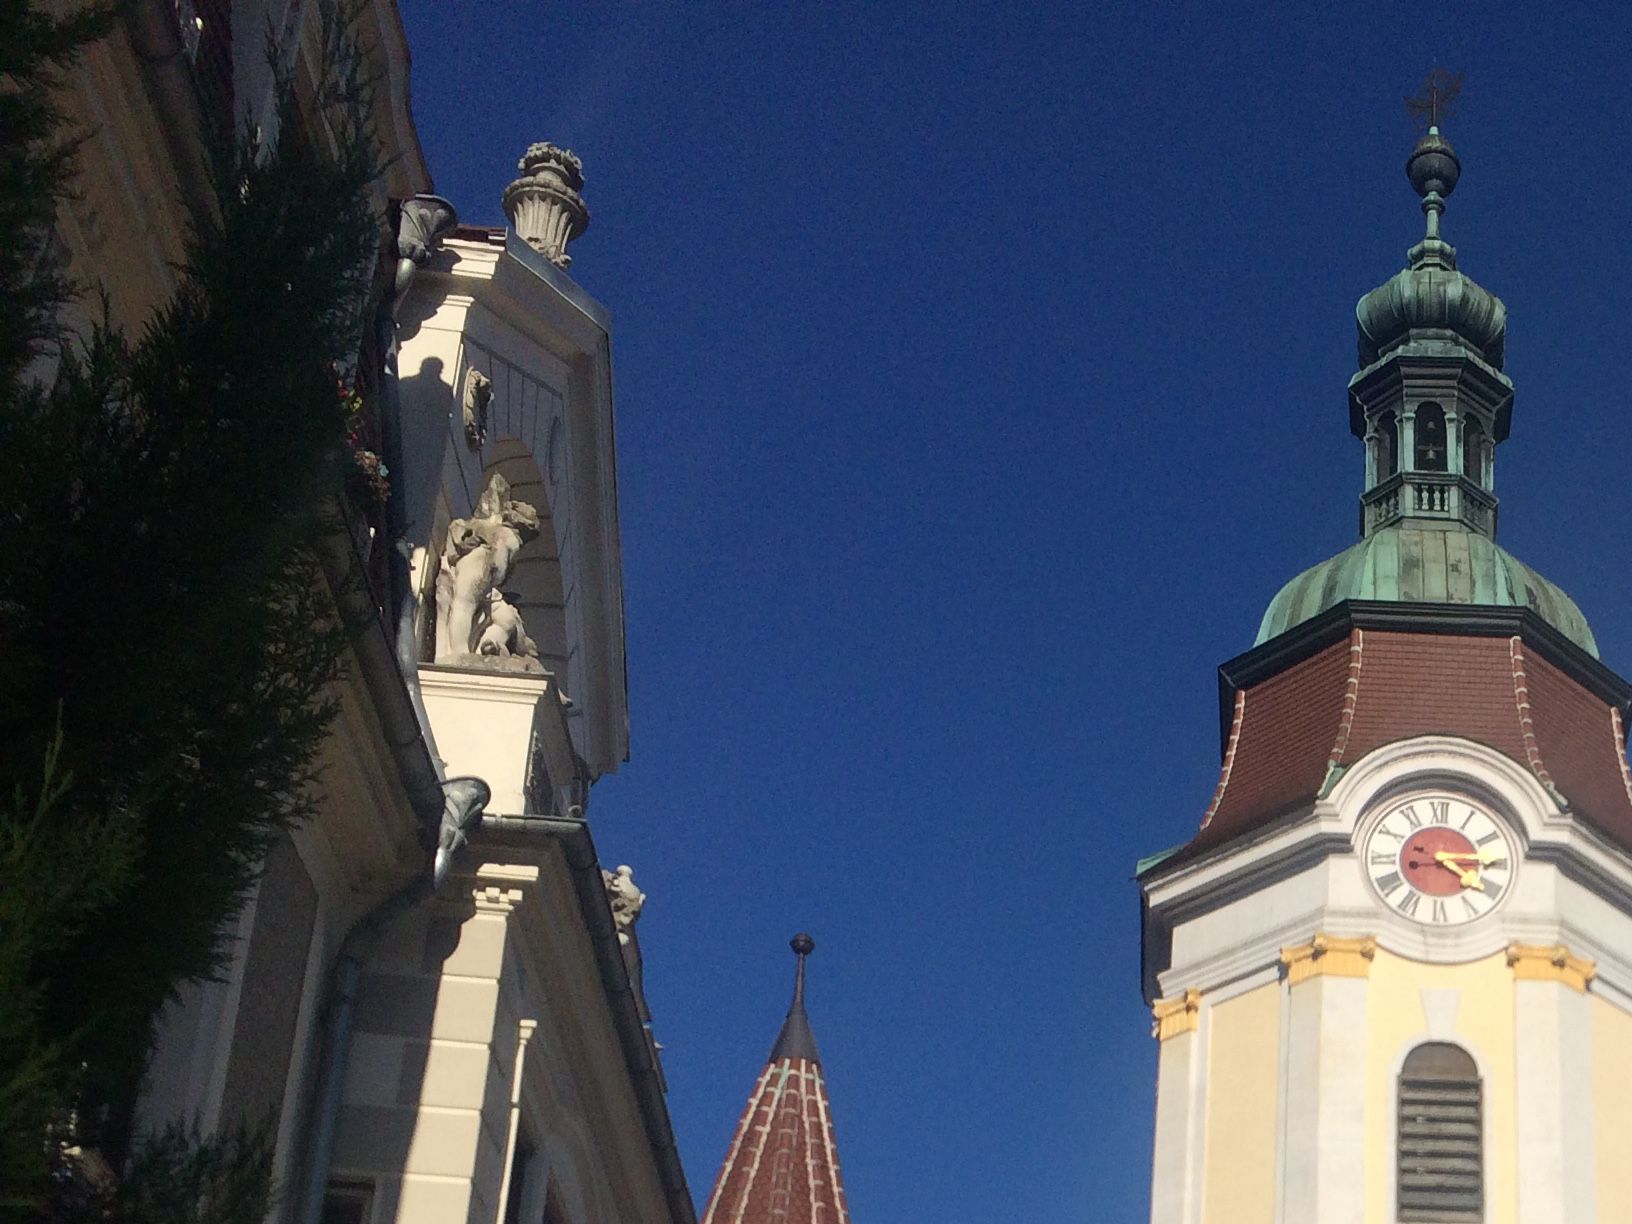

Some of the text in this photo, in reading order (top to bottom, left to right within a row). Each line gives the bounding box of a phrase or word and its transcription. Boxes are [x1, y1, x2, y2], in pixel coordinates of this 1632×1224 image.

[1430, 802, 1449, 823] XII
[1461, 810, 1475, 830] I
[1378, 824, 1405, 844] X
[1432, 899, 1448, 923] VI
[1461, 896, 1479, 918] V
